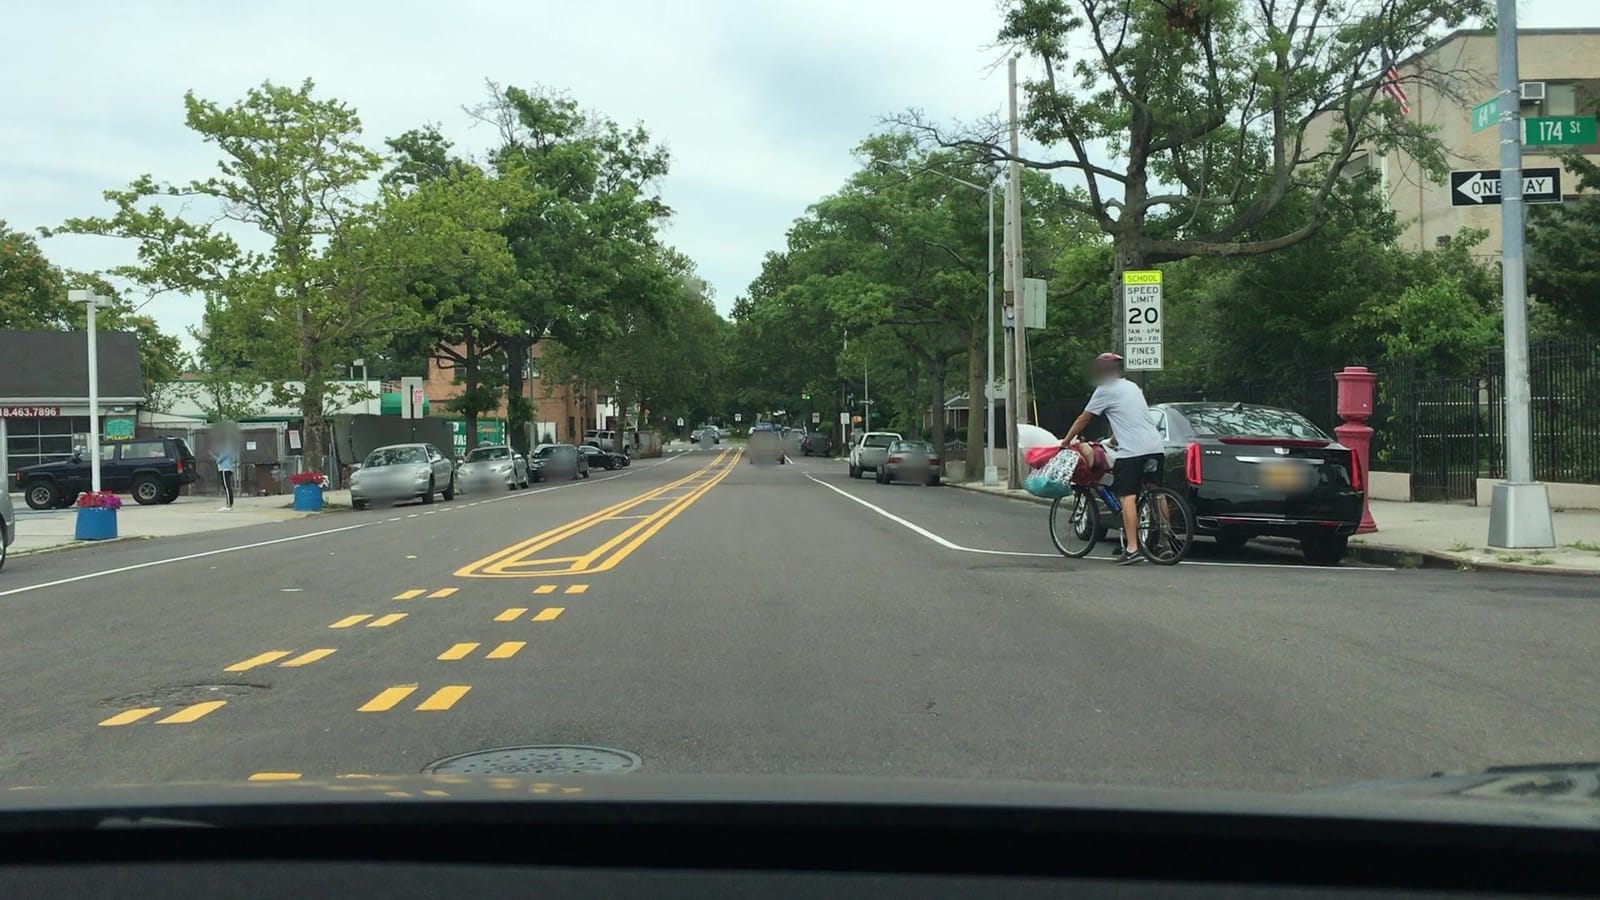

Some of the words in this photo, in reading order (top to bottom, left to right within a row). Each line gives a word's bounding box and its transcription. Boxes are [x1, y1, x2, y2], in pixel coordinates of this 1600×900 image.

[1539, 121, 1563, 141] 174
[1570, 121, 1581, 133] St
[1471, 181, 1501, 194] ONE
[1525, 179, 1545, 192] AY
[1127, 274, 1158, 283] SCHOOL
[1127, 286, 1159, 295] SPEED
[1131, 295, 1155, 304] LIMIT
[1128, 307, 1158, 324] 20
[1131, 346, 1156, 355] FINES
[1128, 357, 1159, 366] HIGHER
